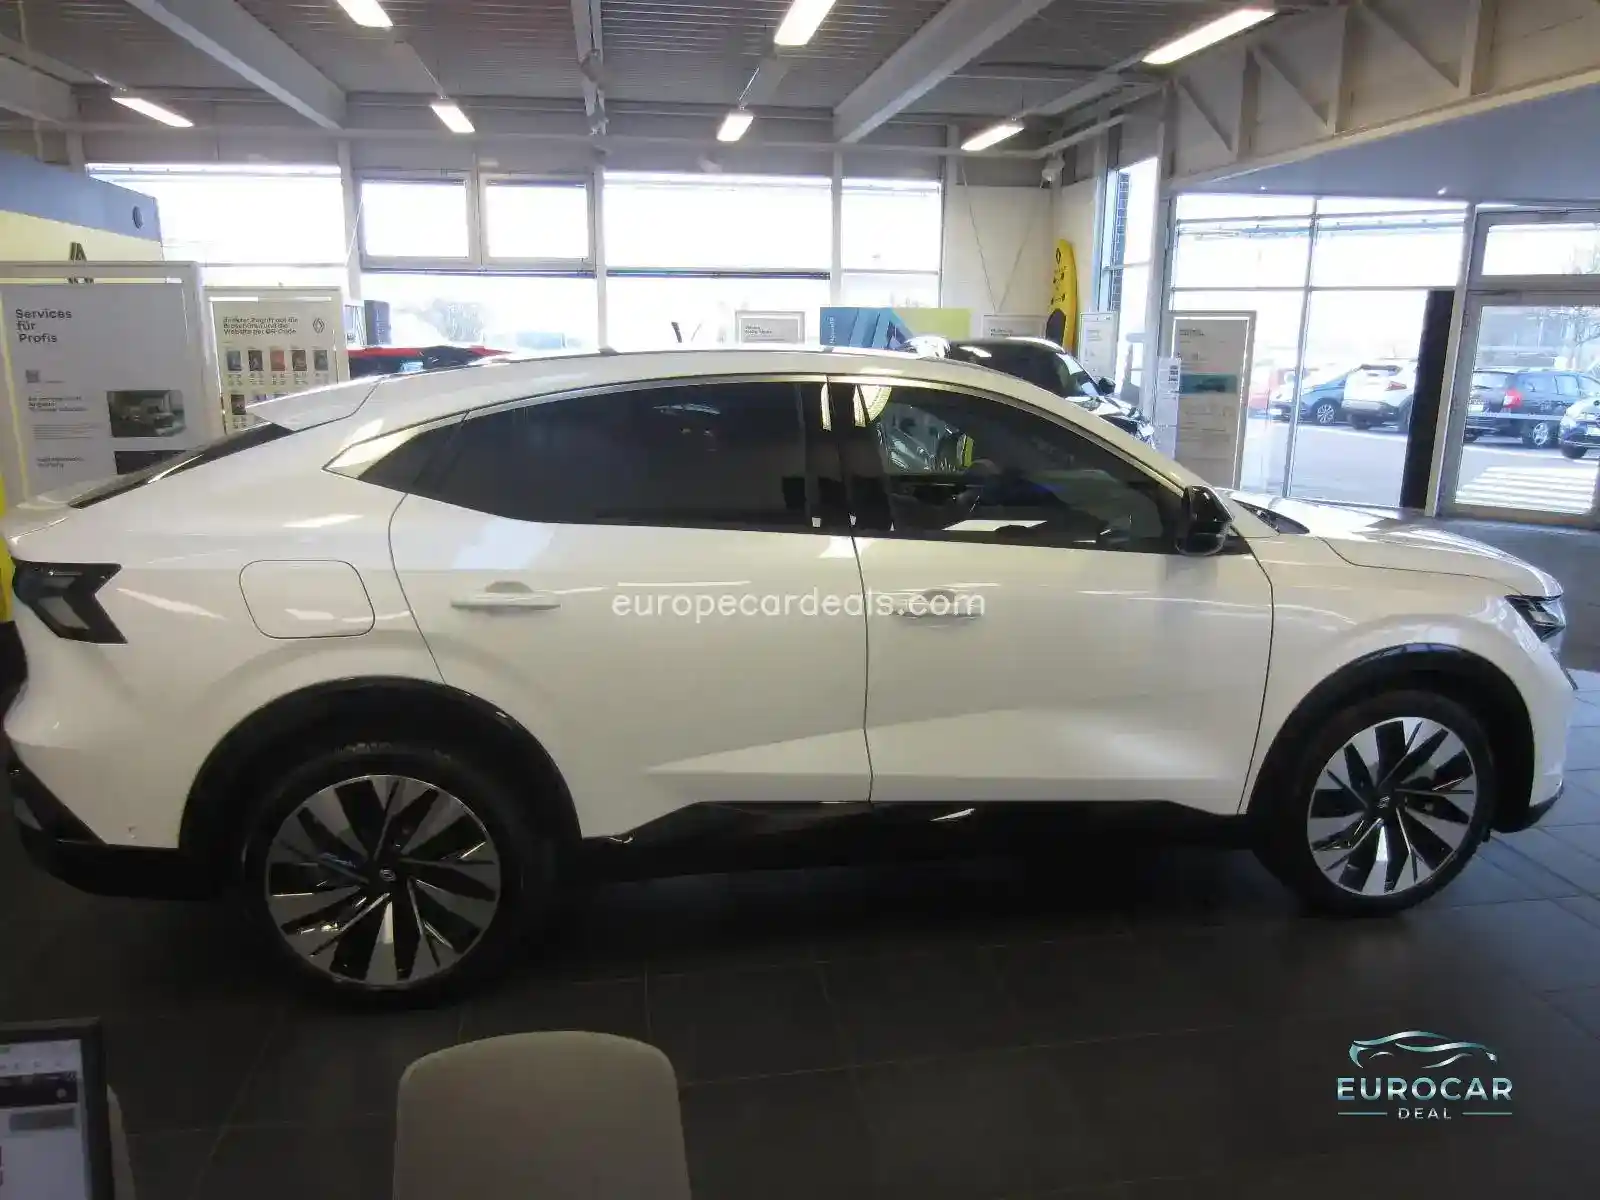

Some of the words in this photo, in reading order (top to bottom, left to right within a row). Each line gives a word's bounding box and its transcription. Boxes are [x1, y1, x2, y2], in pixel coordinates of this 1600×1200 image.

[15, 308, 72, 319] Services
[17, 320, 36, 330] für
[19, 333, 57, 343] Profis
